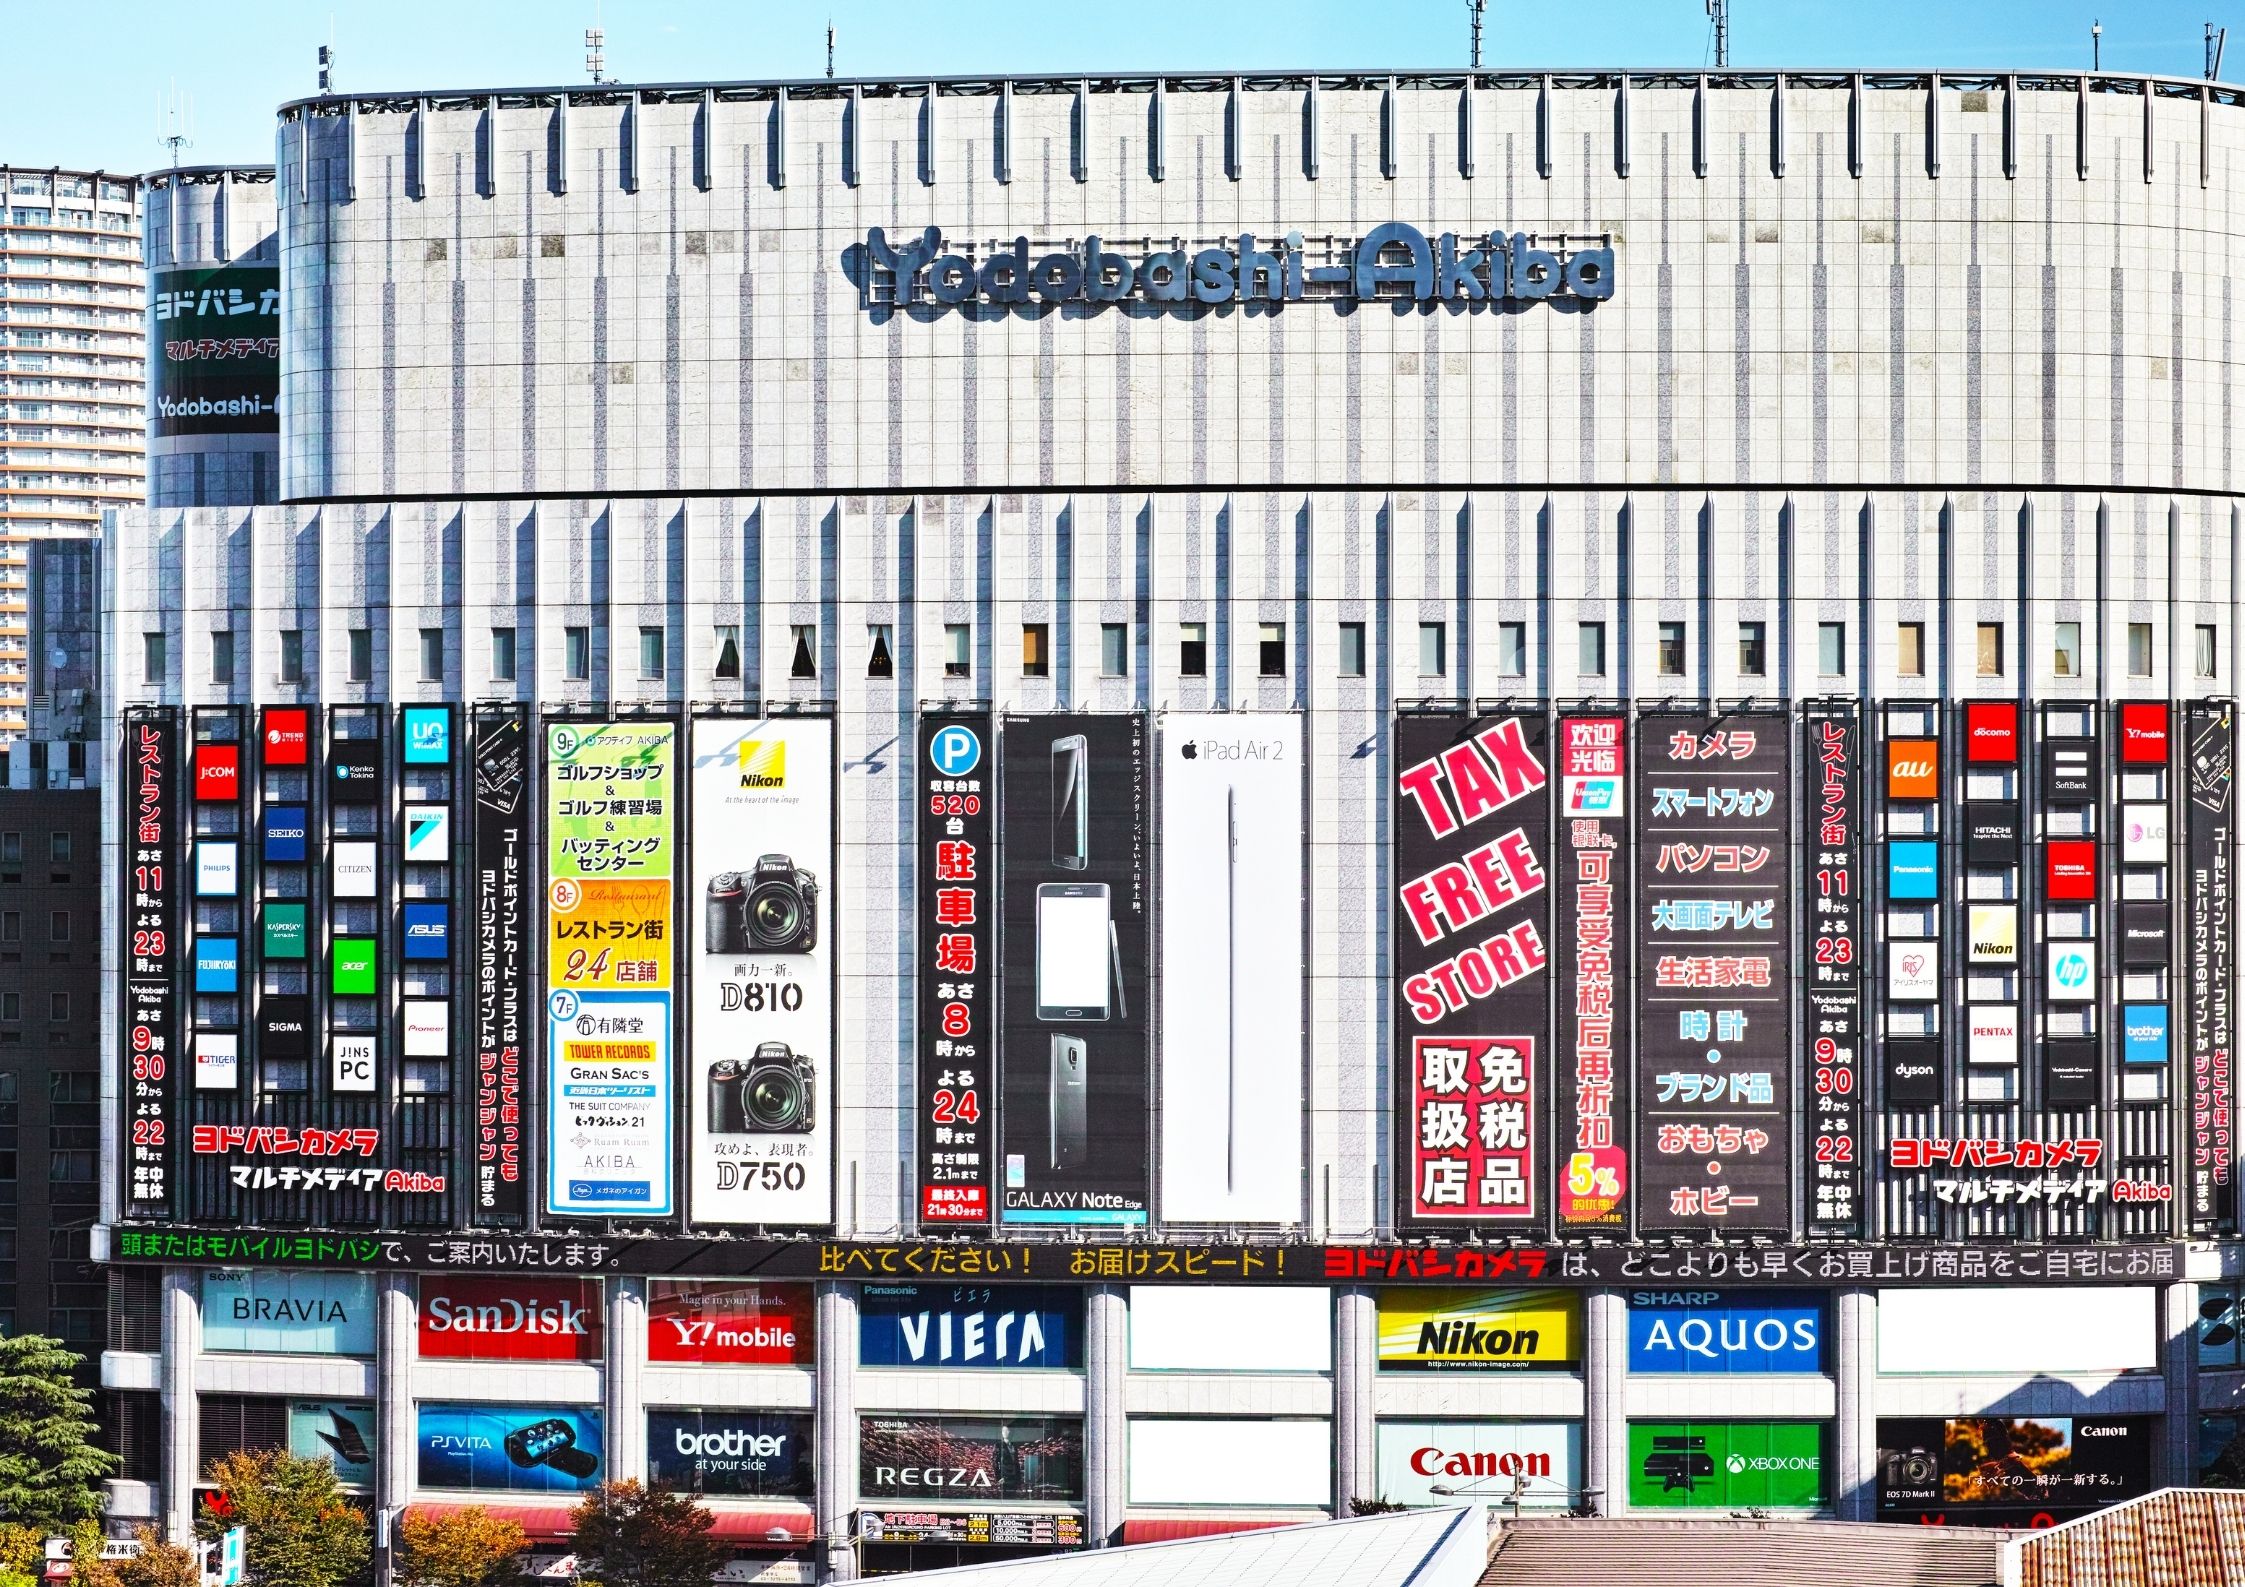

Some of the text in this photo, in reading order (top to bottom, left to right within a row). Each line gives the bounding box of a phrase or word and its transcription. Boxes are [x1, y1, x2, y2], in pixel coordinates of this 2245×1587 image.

[868, 223, 1614, 306] Yodobashi-Akiba
[158, 395, 279, 418] Yodobashi-
[557, 733, 573, 750] 9F
[638, 736, 668, 744] AKIBA
[1571, 724, 1615, 746] 欢迎
[1204, 740, 1283, 760] iPad Air 2
[1668, 731, 1756, 760] カメラ
[1571, 751, 1615, 772] 光临
[1893, 761, 1933, 778] au
[557, 764, 664, 780] ゴルフショップ
[741, 774, 783, 787] Nikon
[1400, 717, 1545, 840] TAX
[139, 725, 160, 842] レストラン街
[1821, 722, 1846, 846] レストラン街
[559, 801, 662, 815] ゴルフ練習場
[931, 795, 980, 815] 520
[1652, 787, 1774, 817] スマートフォン
[946, 818, 963, 834] 台
[2147, 828, 2166, 838] LG
[137, 850, 162, 861] あさ
[562, 838, 660, 854] バッティング
[577, 857, 644, 871] センター
[1656, 843, 1770, 873] パソコン
[136, 866, 162, 891] 11
[1400, 827, 1545, 946] FREE
[137, 894, 162, 907] 時から
[557, 886, 572, 902] 8F
[936, 840, 976, 974] 駐車場
[1652, 899, 1774, 930] 大画面テレビ
[137, 914, 161, 926] よる
[268, 923, 300, 931] KASPERSKY
[557, 920, 663, 940] レストラン街
[134, 931, 165, 955] 23
[2128, 930, 2165, 938] Microsoft
[1974, 943, 2012, 954] Nikon
[136, 959, 163, 972] 時まで
[342, 961, 368, 970] acer
[616, 961, 657, 982] 店舗
[1403, 919, 1545, 1024] STORE
[1656, 956, 1770, 987] 生活家電
[130, 986, 168, 995] Yodobashi
[138, 994, 161, 1003] Akiba
[721, 983, 802, 1011] D810
[937, 983, 974, 999] あさ
[1577, 851, 1613, 1149] 可享受免税后再折扣
[137, 1010, 161, 1021] あさ
[556, 997, 572, 1014] 7F
[269, 1023, 302, 1031] SIGMA
[942, 1002, 970, 1037] 8
[1680, 1010, 1747, 1041] 時計
[1974, 1028, 2013, 1036] PENTAX
[2128, 1026, 2164, 1036] brother
[570, 1045, 650, 1058] TOWER RECORDS
[936, 1041, 975, 1056] 時から
[133, 1054, 165, 1080] 30
[340, 1061, 369, 1080] PC
[571, 1068, 649, 1079] GRAN SAC'S
[1896, 1063, 1933, 1078] dyson
[938, 1070, 974, 1086] よる
[1656, 1072, 1773, 1103] ブランド品
[136, 1082, 163, 1096] 分から
[137, 1103, 161, 1115] よる
[501, 1046, 519, 1182] どこで使っても
[569, 1102, 651, 1110] THE SUIT COMPANY
[933, 1089, 980, 1124] 24
[133, 1119, 165, 1145] 22
[479, 1053, 497, 1206] ジャンジャン 貯まる
[632, 1117, 644, 1127] 21
[1421, 1046, 1469, 1205] 取扱店
[1478, 1044, 1528, 1205] 免税品
[193, 1125, 378, 1156] ヨドバシカメラ
[936, 1128, 975, 1144] 時まで
[1658, 1124, 1768, 1154] おもちゃ
[136, 1147, 162, 1161] 時まで
[584, 1155, 634, 1167] AKIBA
[1891, 1139, 2102, 1167] ヨドバシカメラ
[230, 1166, 445, 1193] マルチメディア Akiba
[717, 1162, 805, 1191] D750
[1568, 1153, 1619, 1196] 5%
[1007, 1192, 1142, 1210] GALAXY Note Edge
[1670, 1186, 1758, 1215] ホビー
[1933, 1179, 2171, 1203] マルチメディア Akiba
[2196, 1170, 2209, 1212] 貯まる
[1324, 1249, 1546, 1278] ヨドバシカメラ
[209, 1272, 244, 1282] SONY
[680, 1294, 786, 1307] Magic in your Hands.
[865, 1286, 917, 1295] Panasonic
[953, 1286, 990, 1303] ビエラ
[1634, 1292, 1719, 1304] SHARP
[233, 1298, 347, 1322] BRAVIA
[430, 1297, 588, 1335] SanDisk
[717, 1327, 796, 1348] mobile
[900, 1310, 1045, 1363] VIERA
[1417, 1321, 1539, 1355] Nikon
[1644, 1318, 1816, 1357] AQUOS
[2081, 1426, 2127, 1436] Canon
[676, 1428, 786, 1456] brother
[695, 1458, 766, 1473] at your side
[1410, 1447, 1549, 1477] Canon
[1748, 1457, 1819, 1470] XBOX ONE
[876, 1467, 991, 1487] REGZA
[1913, 1490, 1929, 1498] Mark
[884, 1513, 938, 1526] 地下駐車場
